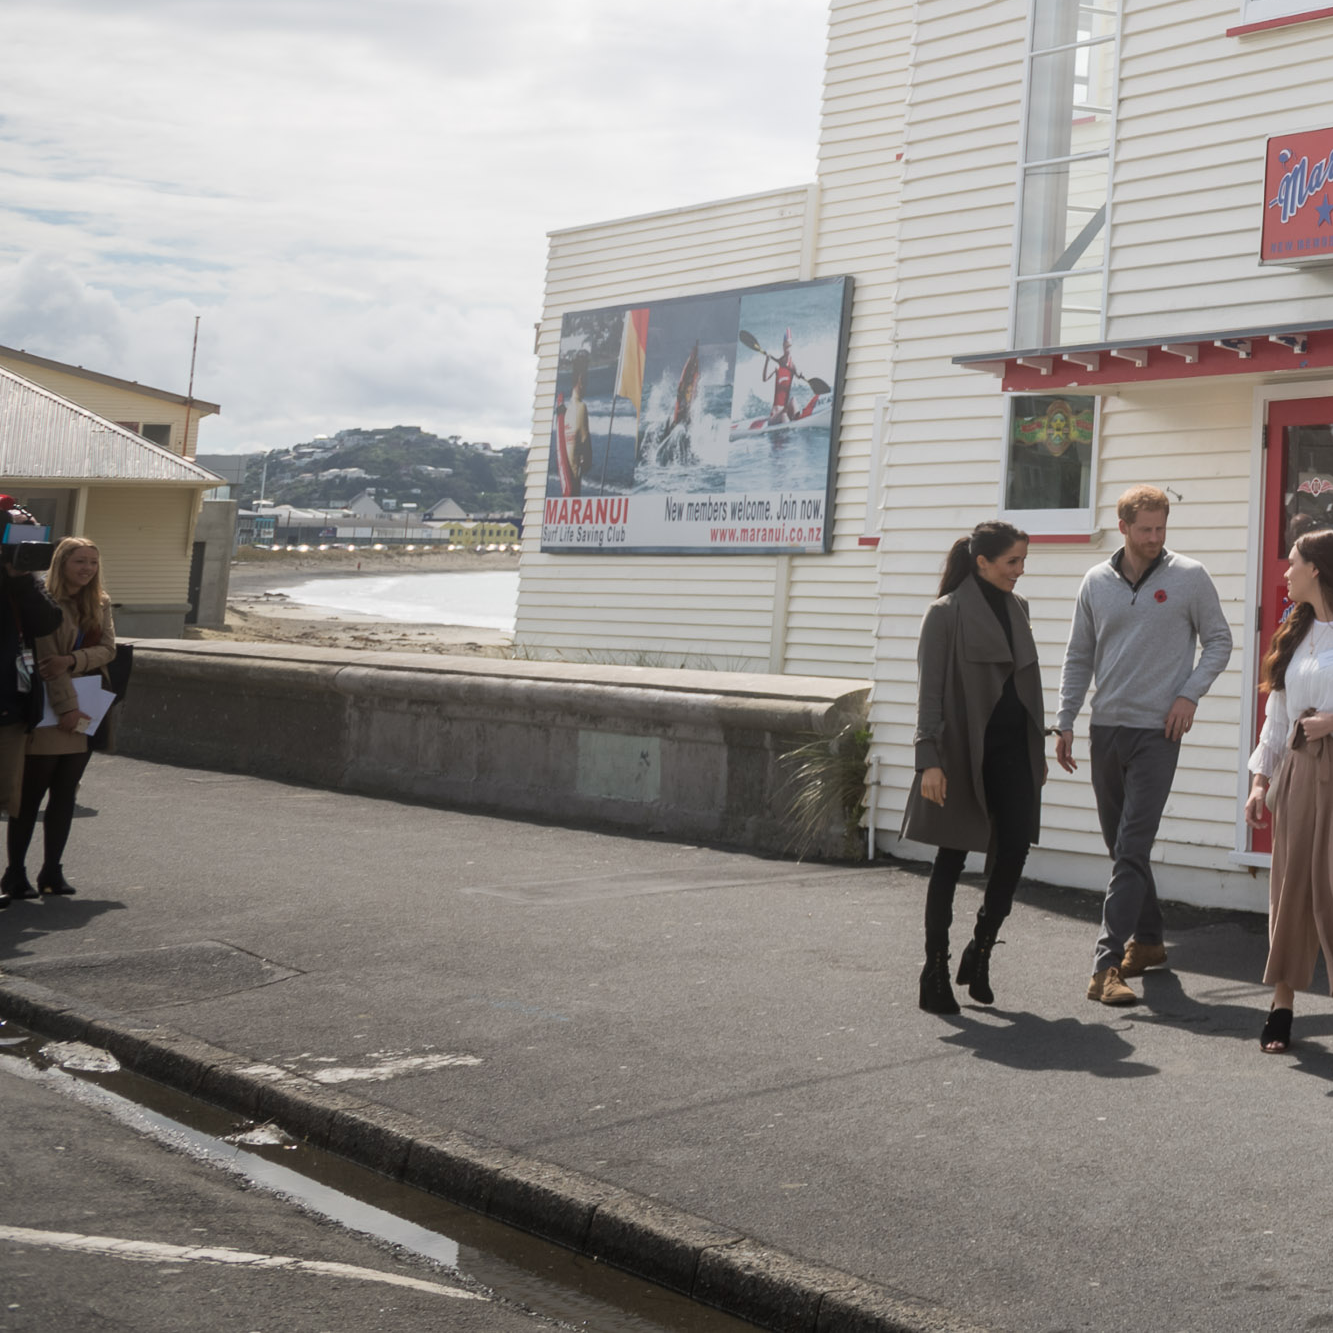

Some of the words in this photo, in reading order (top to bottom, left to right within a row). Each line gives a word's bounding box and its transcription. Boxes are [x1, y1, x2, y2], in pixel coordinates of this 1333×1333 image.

[1270, 240, 1293, 254] NEW
[545, 497, 629, 525] MARANUI
[664, 495, 685, 522] New
[686, 495, 728, 522] members
[730, 494, 773, 522] welcome.
[776, 493, 797, 521] Join
[800, 498, 824, 521] now.
[543, 525, 559, 543] Surf
[560, 525, 575, 543] Life
[576, 525, 604, 546] Saving
[606, 525, 626, 543] Club
[710, 522, 822, 543] www.maranui.co.nz
